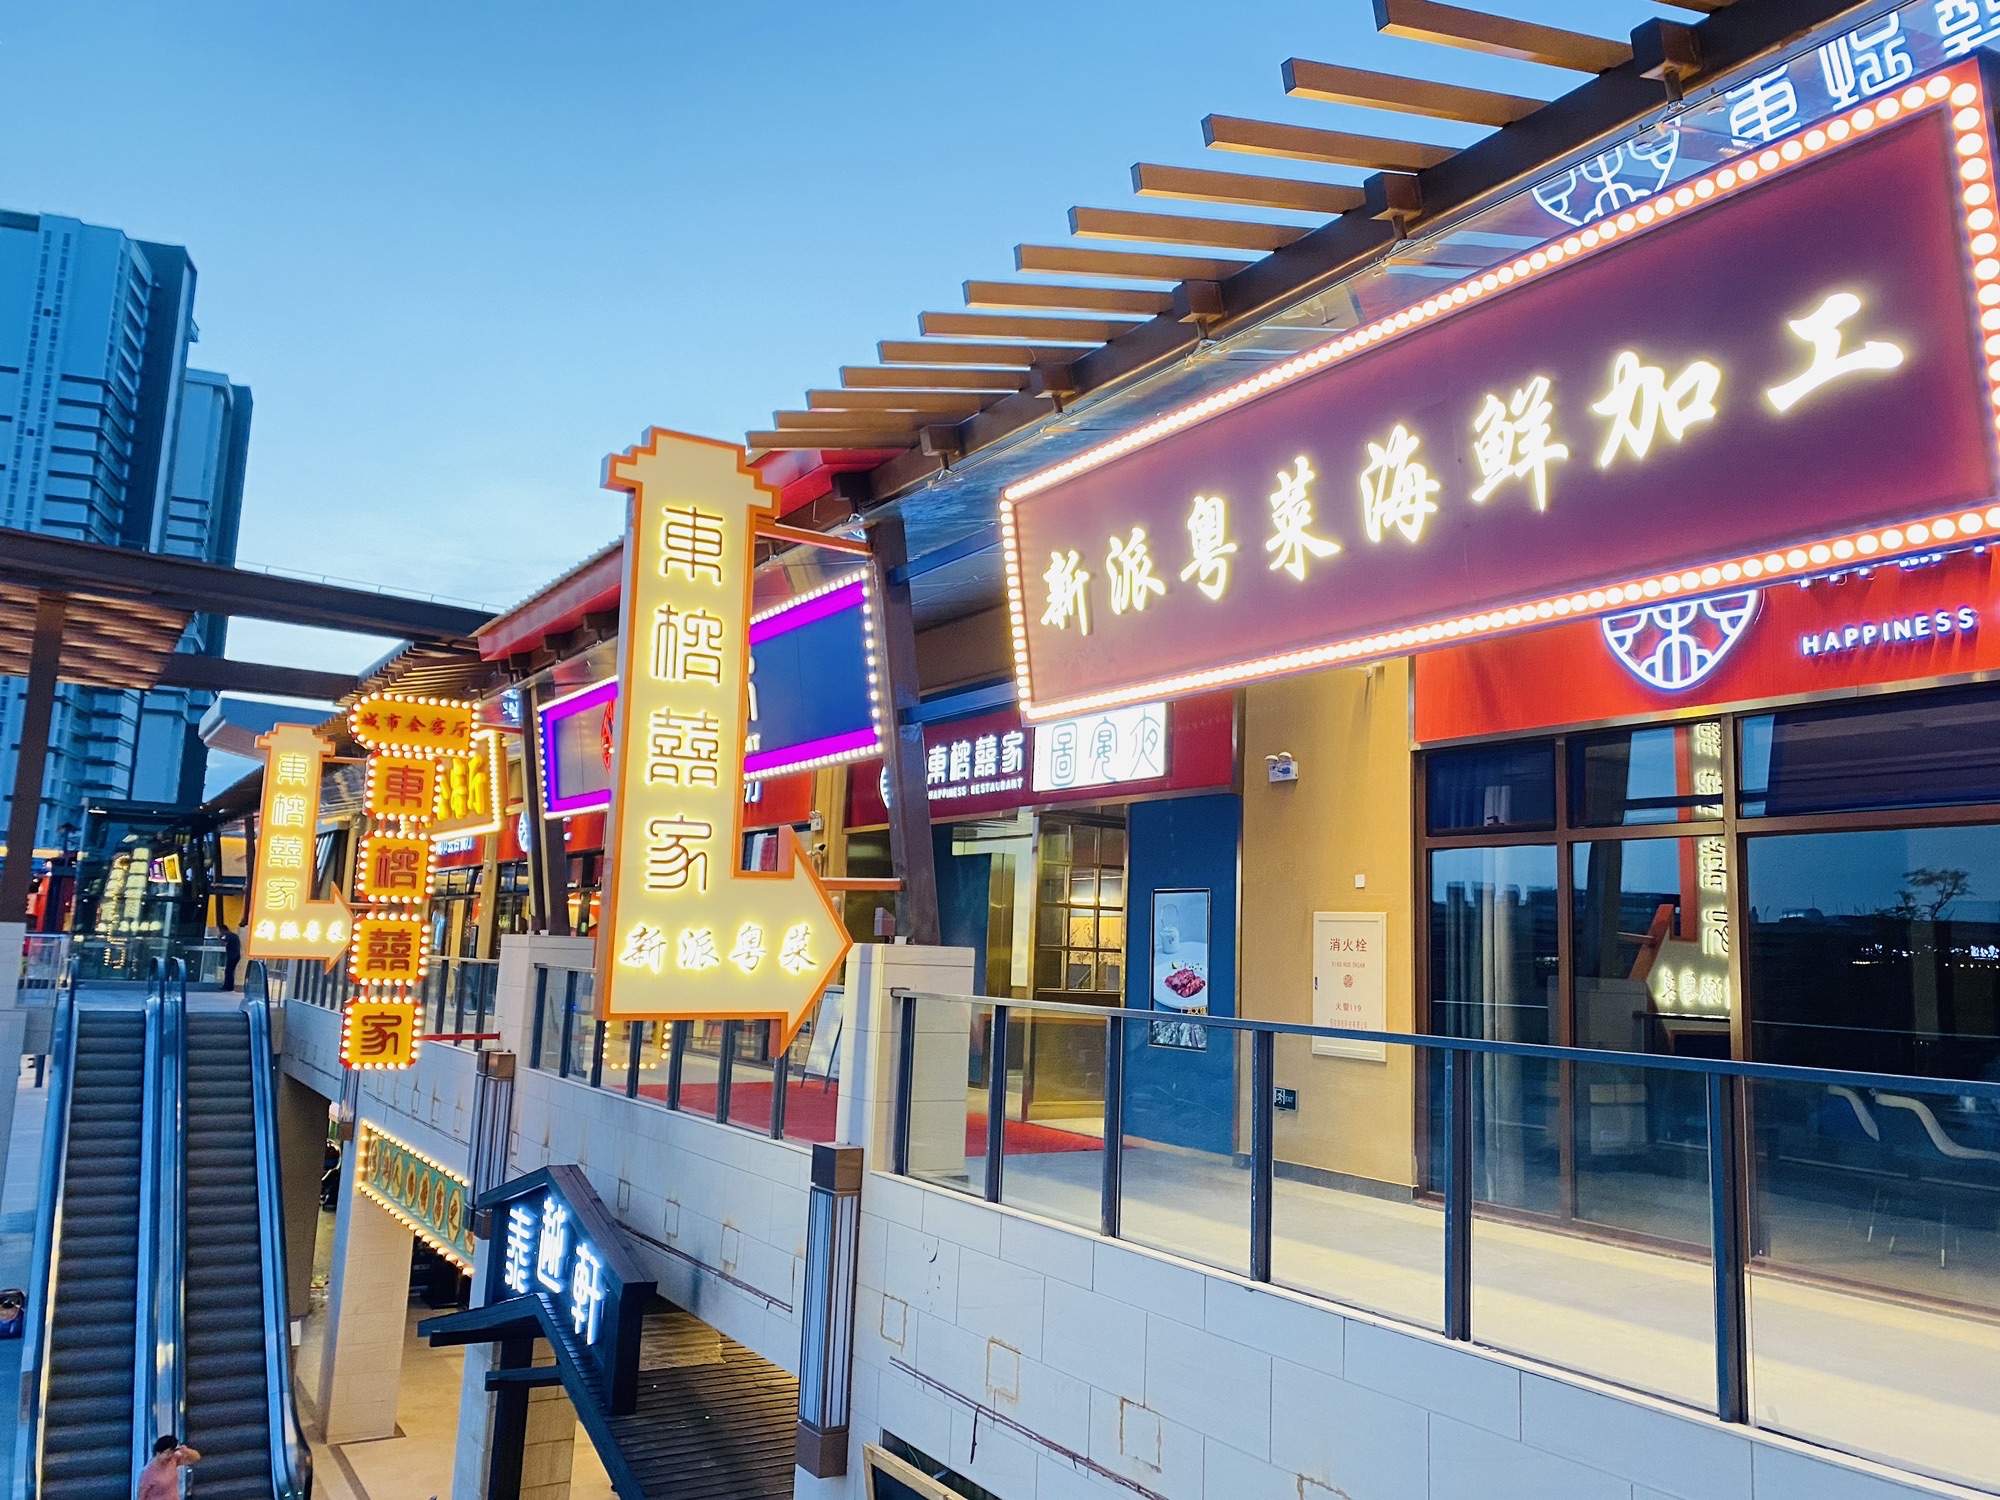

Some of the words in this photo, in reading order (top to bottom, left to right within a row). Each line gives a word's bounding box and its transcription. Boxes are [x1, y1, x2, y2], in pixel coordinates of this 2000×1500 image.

[1802, 607, 1975, 655] HAPPINESS
[928, 786, 967, 800] HAPPINESS
[970, 778, 1024, 795] RESTAURANT
[1330, 938, 1367, 952] 消火栓
